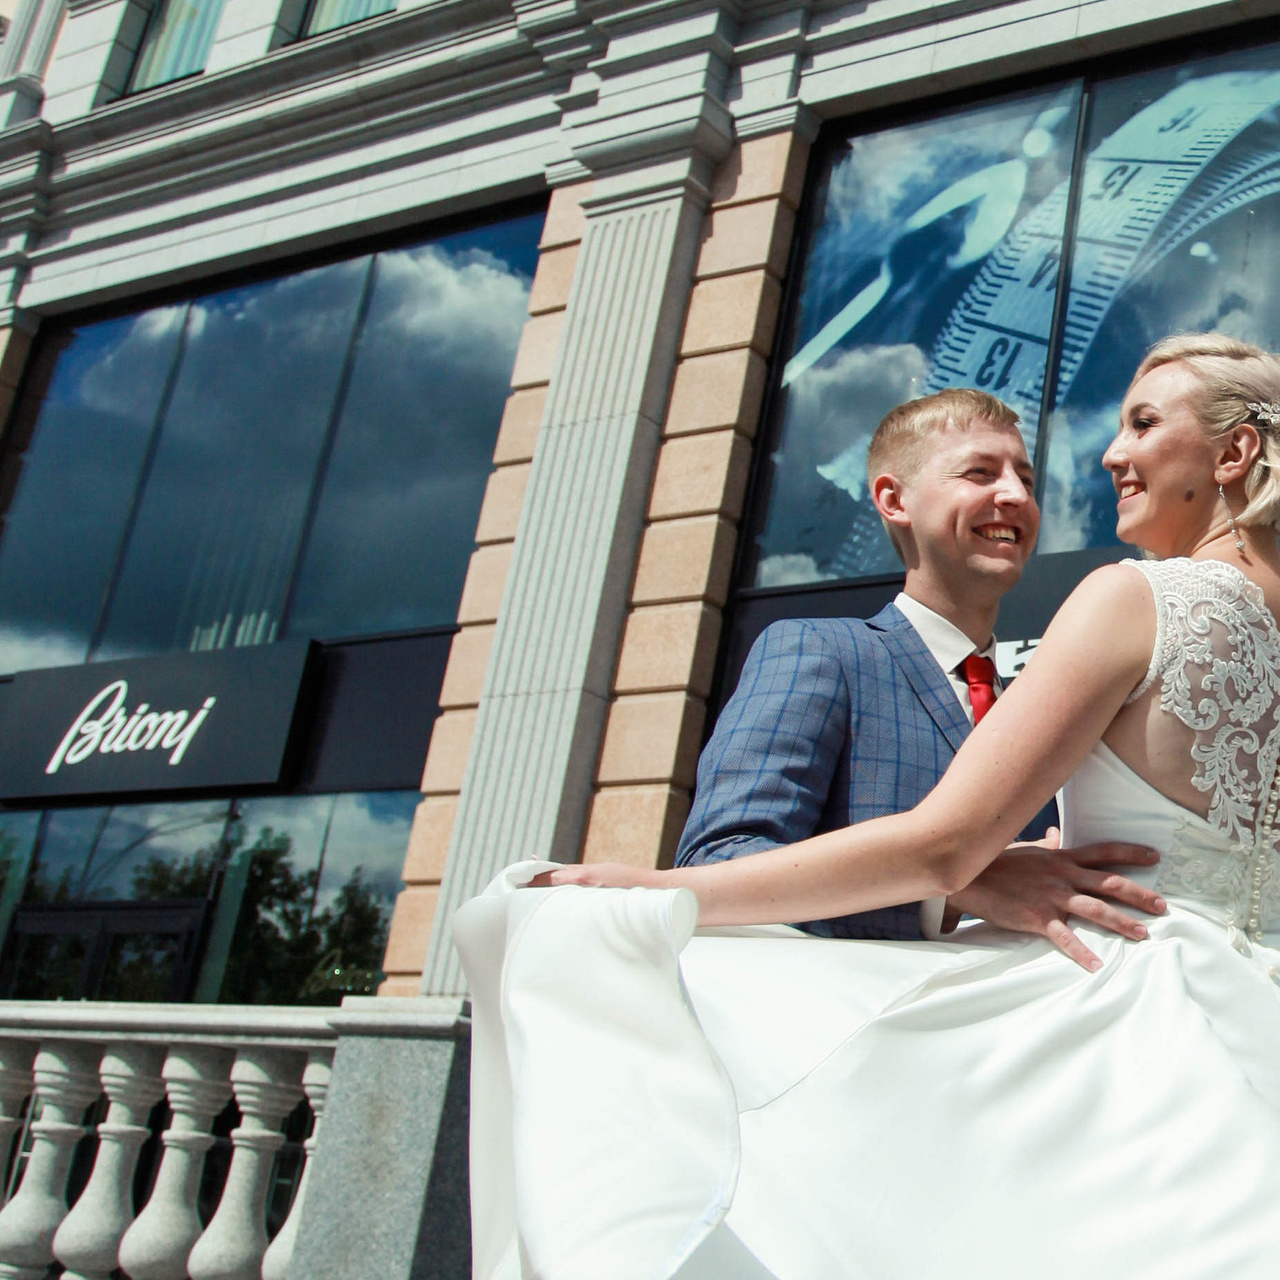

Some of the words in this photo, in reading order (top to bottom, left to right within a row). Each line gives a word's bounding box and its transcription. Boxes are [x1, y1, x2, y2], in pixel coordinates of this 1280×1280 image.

[1088, 165, 1143, 201] 15
[975, 337, 1023, 391] 13
[45, 679, 216, 774] Brioni
